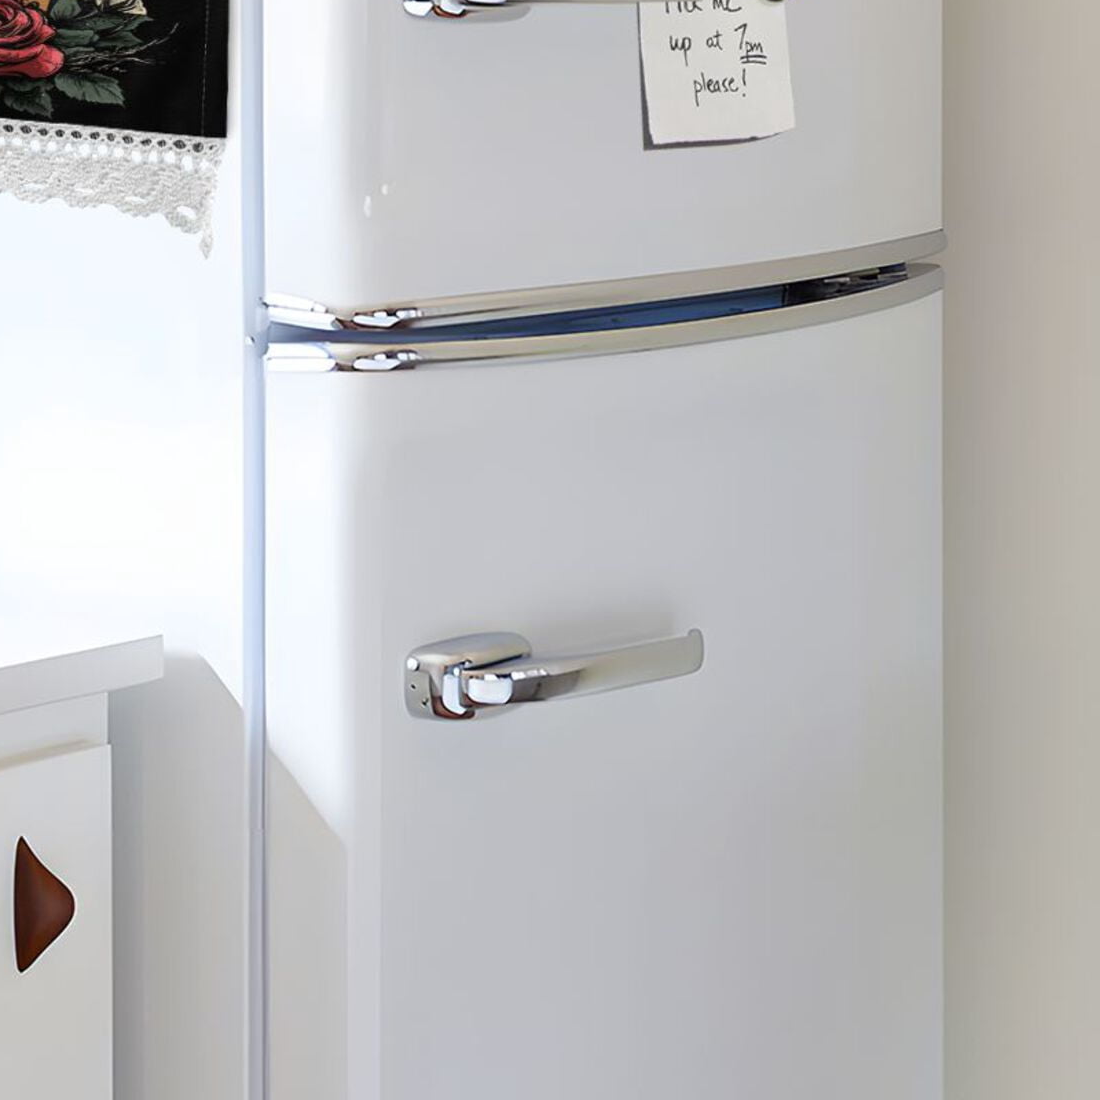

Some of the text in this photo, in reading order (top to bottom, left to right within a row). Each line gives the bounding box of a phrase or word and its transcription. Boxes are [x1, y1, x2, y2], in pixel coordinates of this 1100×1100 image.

[669, 34, 692, 67] up
[705, 29, 723, 51] at
[693, 68, 747, 107] please!
